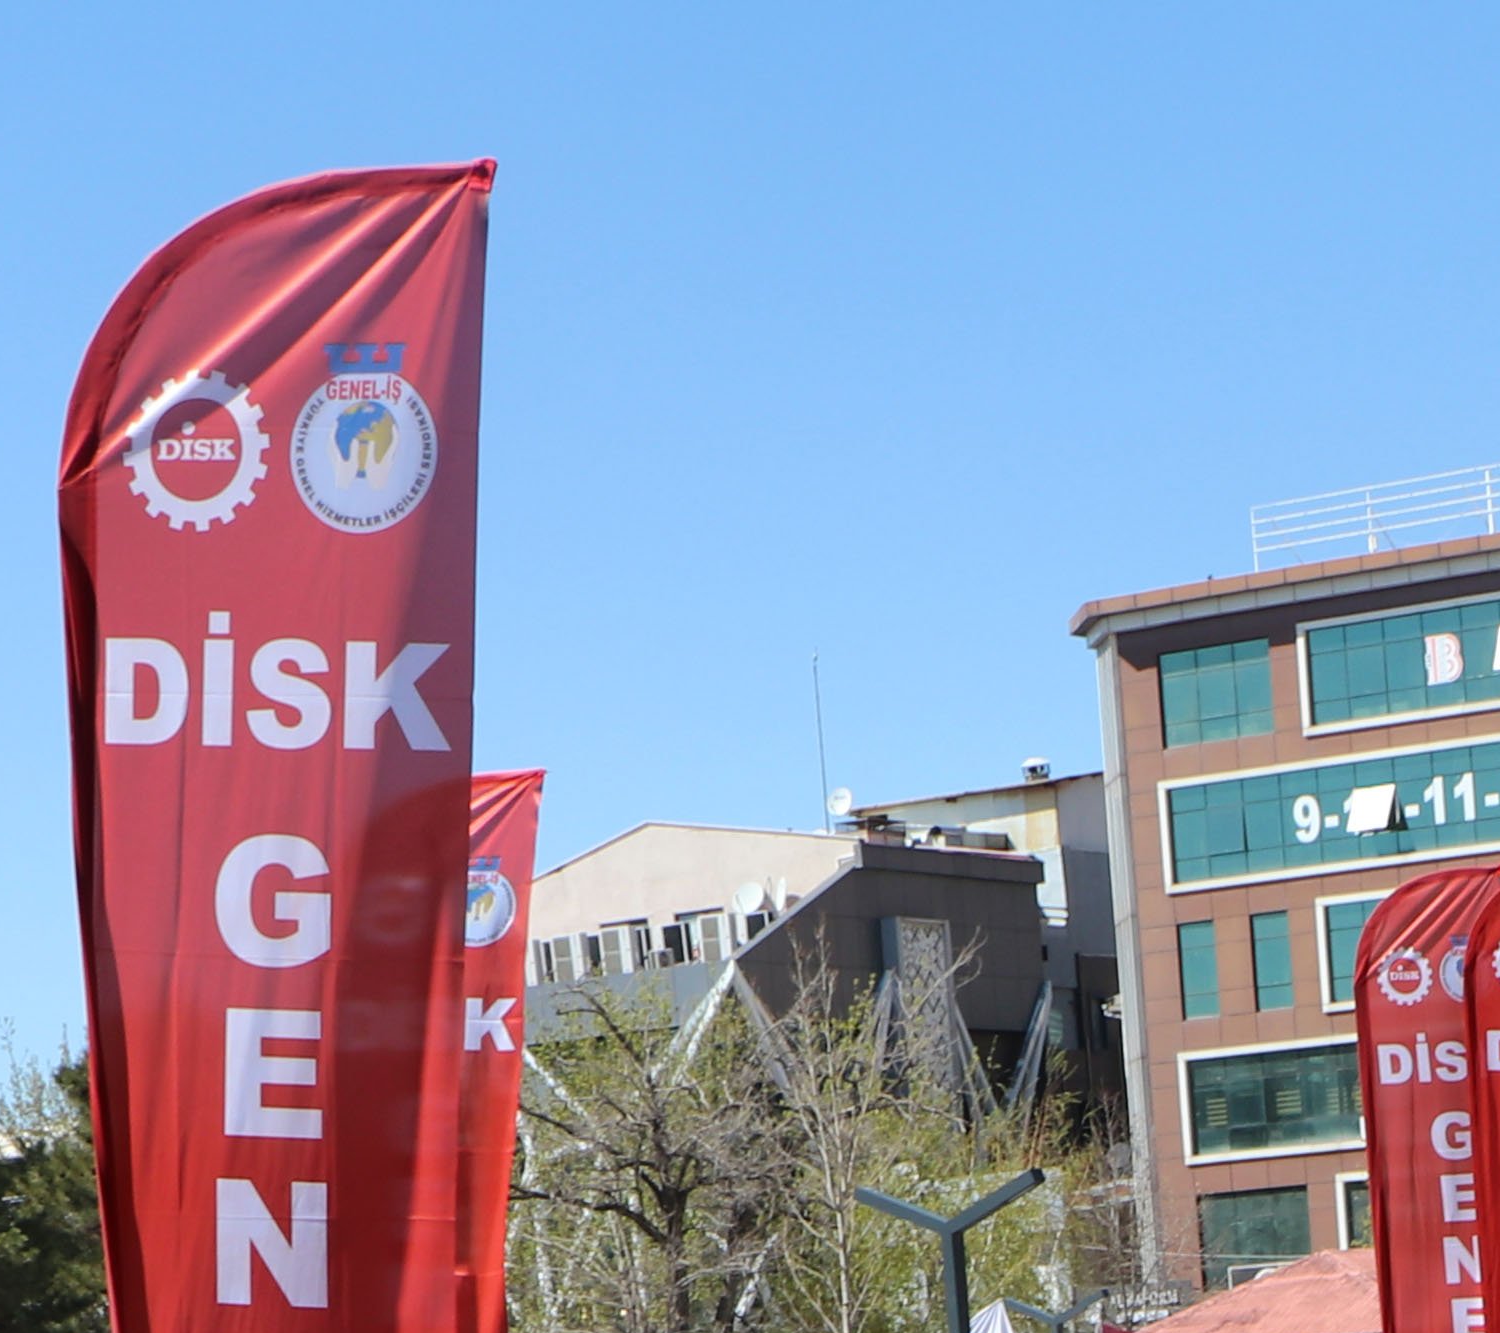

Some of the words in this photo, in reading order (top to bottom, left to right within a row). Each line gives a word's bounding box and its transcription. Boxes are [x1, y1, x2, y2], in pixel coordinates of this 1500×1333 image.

[326, 374, 403, 405] GENEL-İŞ
[157, 421, 237, 463] DİSK
[405, 396, 432, 470] SENDİKASI
[295, 457, 316, 501] GENEL
[384, 471, 428, 521] İŞÇİLERİ
[314, 498, 383, 528] HİZMETLER
[104, 610, 452, 752] DİSK
[1376, 1031, 1469, 1086] DİS
